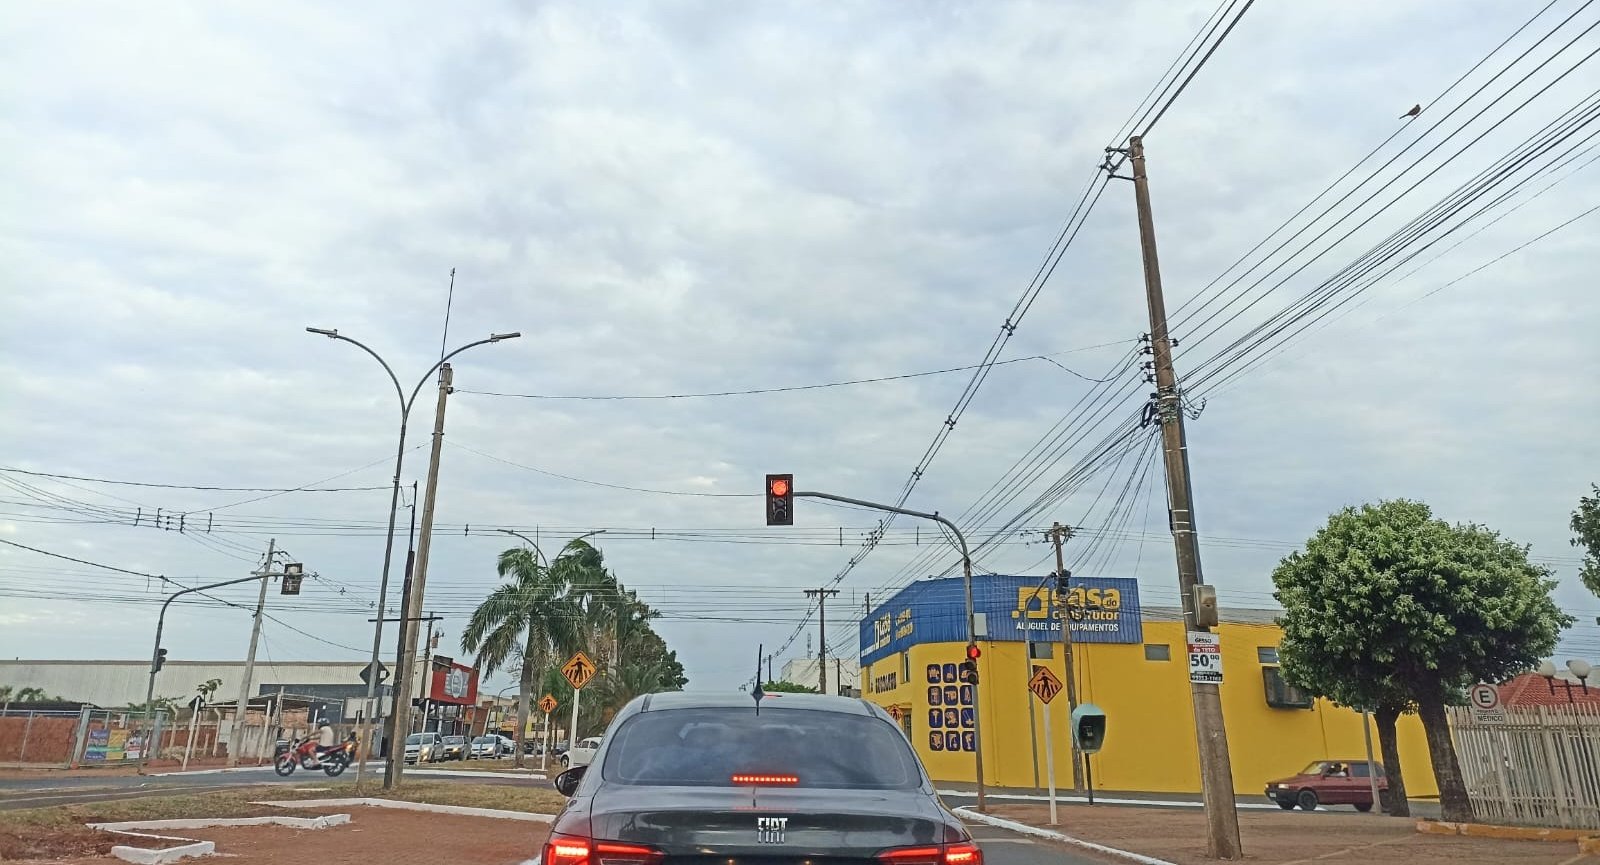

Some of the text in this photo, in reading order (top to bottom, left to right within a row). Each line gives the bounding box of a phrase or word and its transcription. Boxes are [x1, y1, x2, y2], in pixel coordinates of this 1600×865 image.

[1051, 622, 1061, 631] DE
[1069, 622, 1119, 632] UIPAMENTOS
[1479, 690, 1491, 703] E
[758, 817, 788, 844] FIAT
